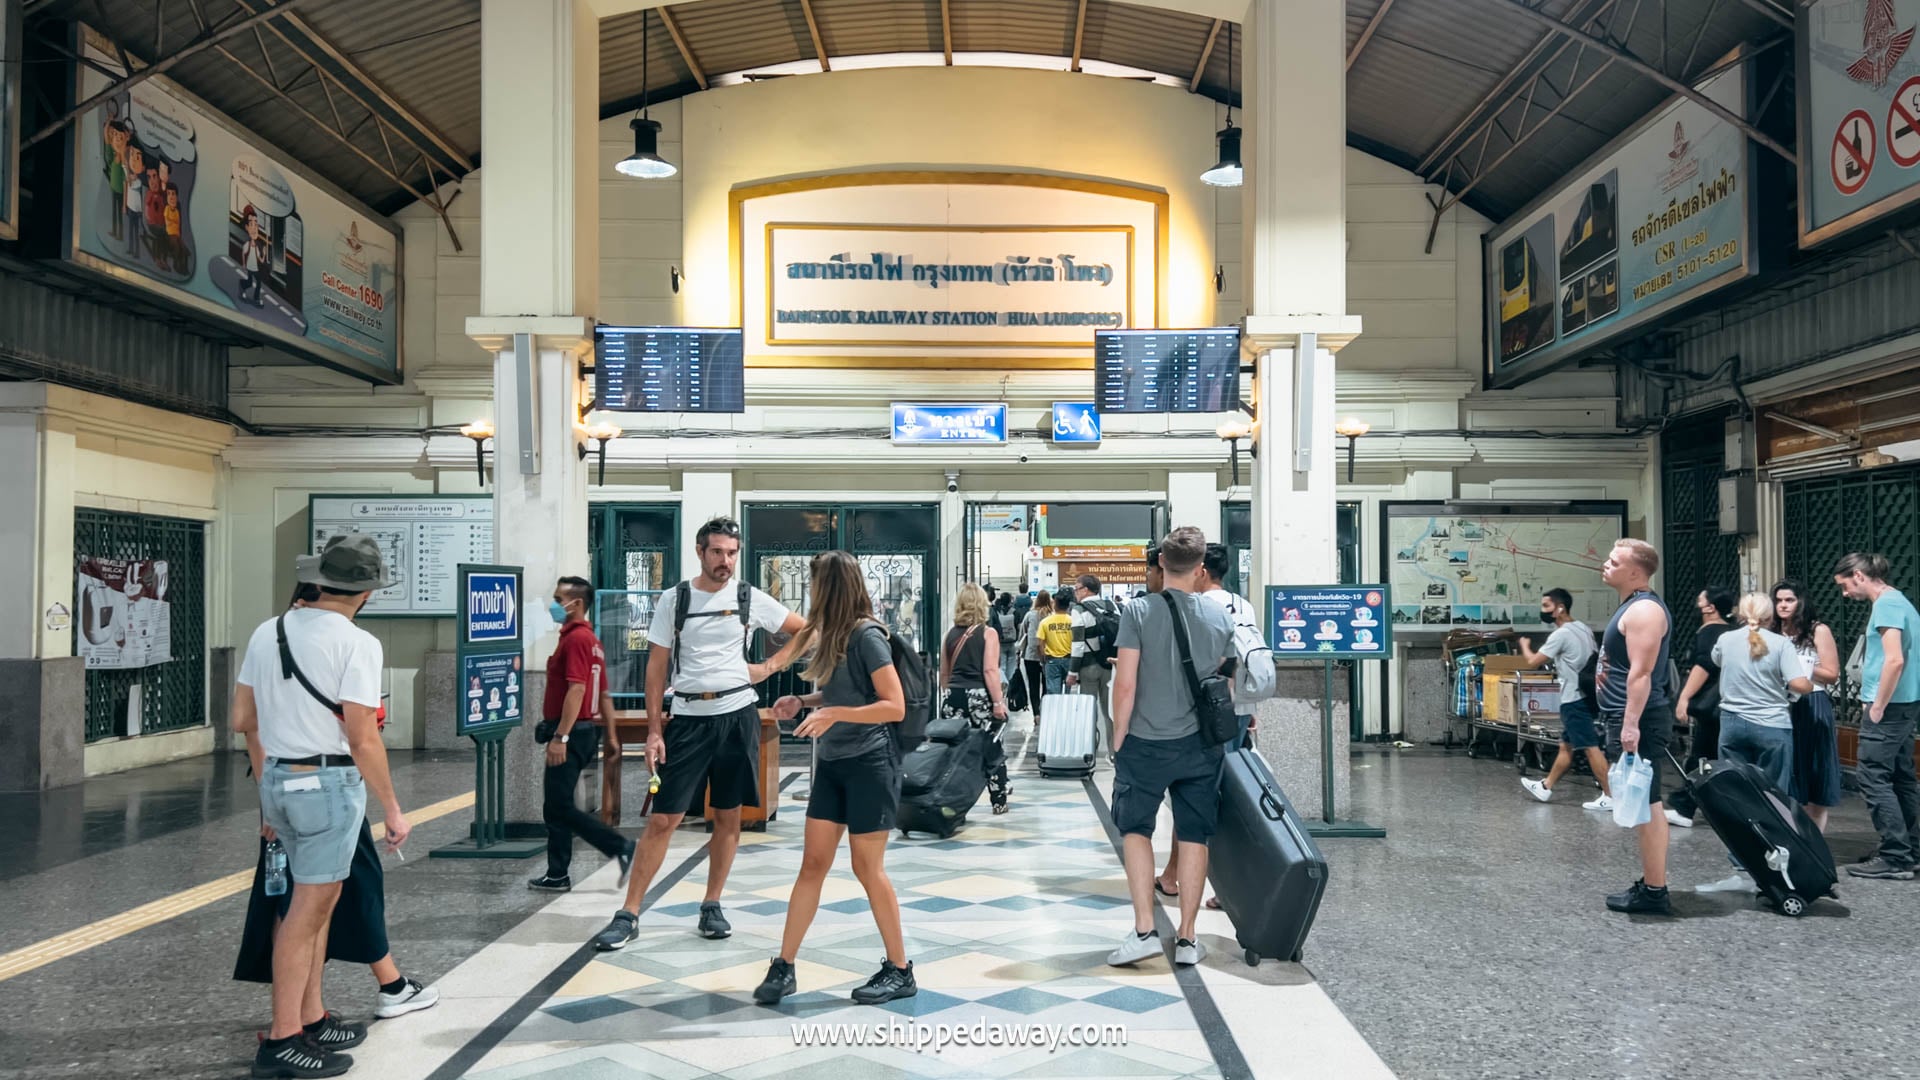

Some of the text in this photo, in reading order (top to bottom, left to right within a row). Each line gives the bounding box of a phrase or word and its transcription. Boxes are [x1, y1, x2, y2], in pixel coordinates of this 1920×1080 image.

[1632, 167, 1736, 248] รถจักรดีเซลไฟฟ้า
[1655, 240, 1676, 266] CSR
[786, 252, 903, 281] สถานีรถไฟ
[912, 264, 993, 289] กรุงเทพ
[1633, 239, 1737, 301] หมายเลข 5101-5120
[322, 272, 383, 311] Call Center 1690
[323, 295, 383, 331] www.railway.co.th
[776, 309, 852, 324] BANGKOK
[855, 310, 928, 325] RAILWAY
[932, 310, 997, 326] STATION
[927, 409, 996, 428] ทางเข้า
[940, 428, 986, 438] ENTRY
[1088, 563, 1148, 574] หน่วยบริการเดินทา
[1109, 574, 1148, 582] Informatio
[471, 582, 506, 615] ทางเข้า
[471, 620, 506, 631] ENTRANCE
[1530, 702, 1538, 710] 10
